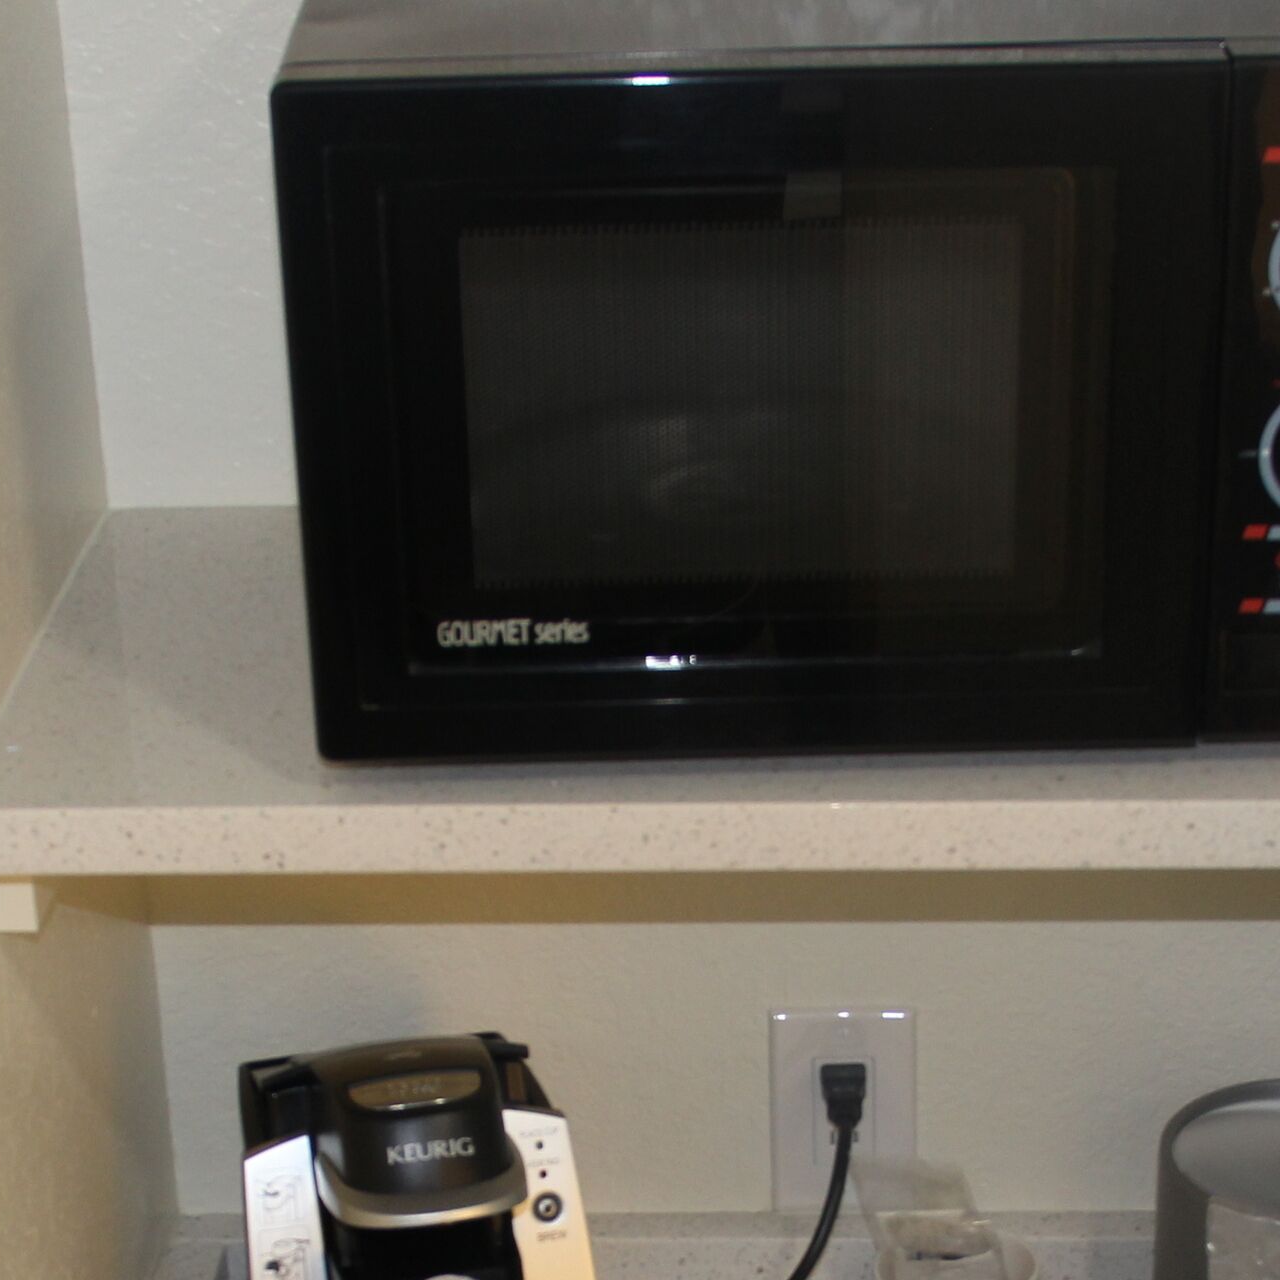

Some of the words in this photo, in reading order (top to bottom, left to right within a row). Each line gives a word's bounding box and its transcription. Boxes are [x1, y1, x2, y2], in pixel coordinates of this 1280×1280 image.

[436, 618, 531, 648] GOURMET
[533, 618, 591, 645] series
[386, 1136, 475, 1166] KEURIG
